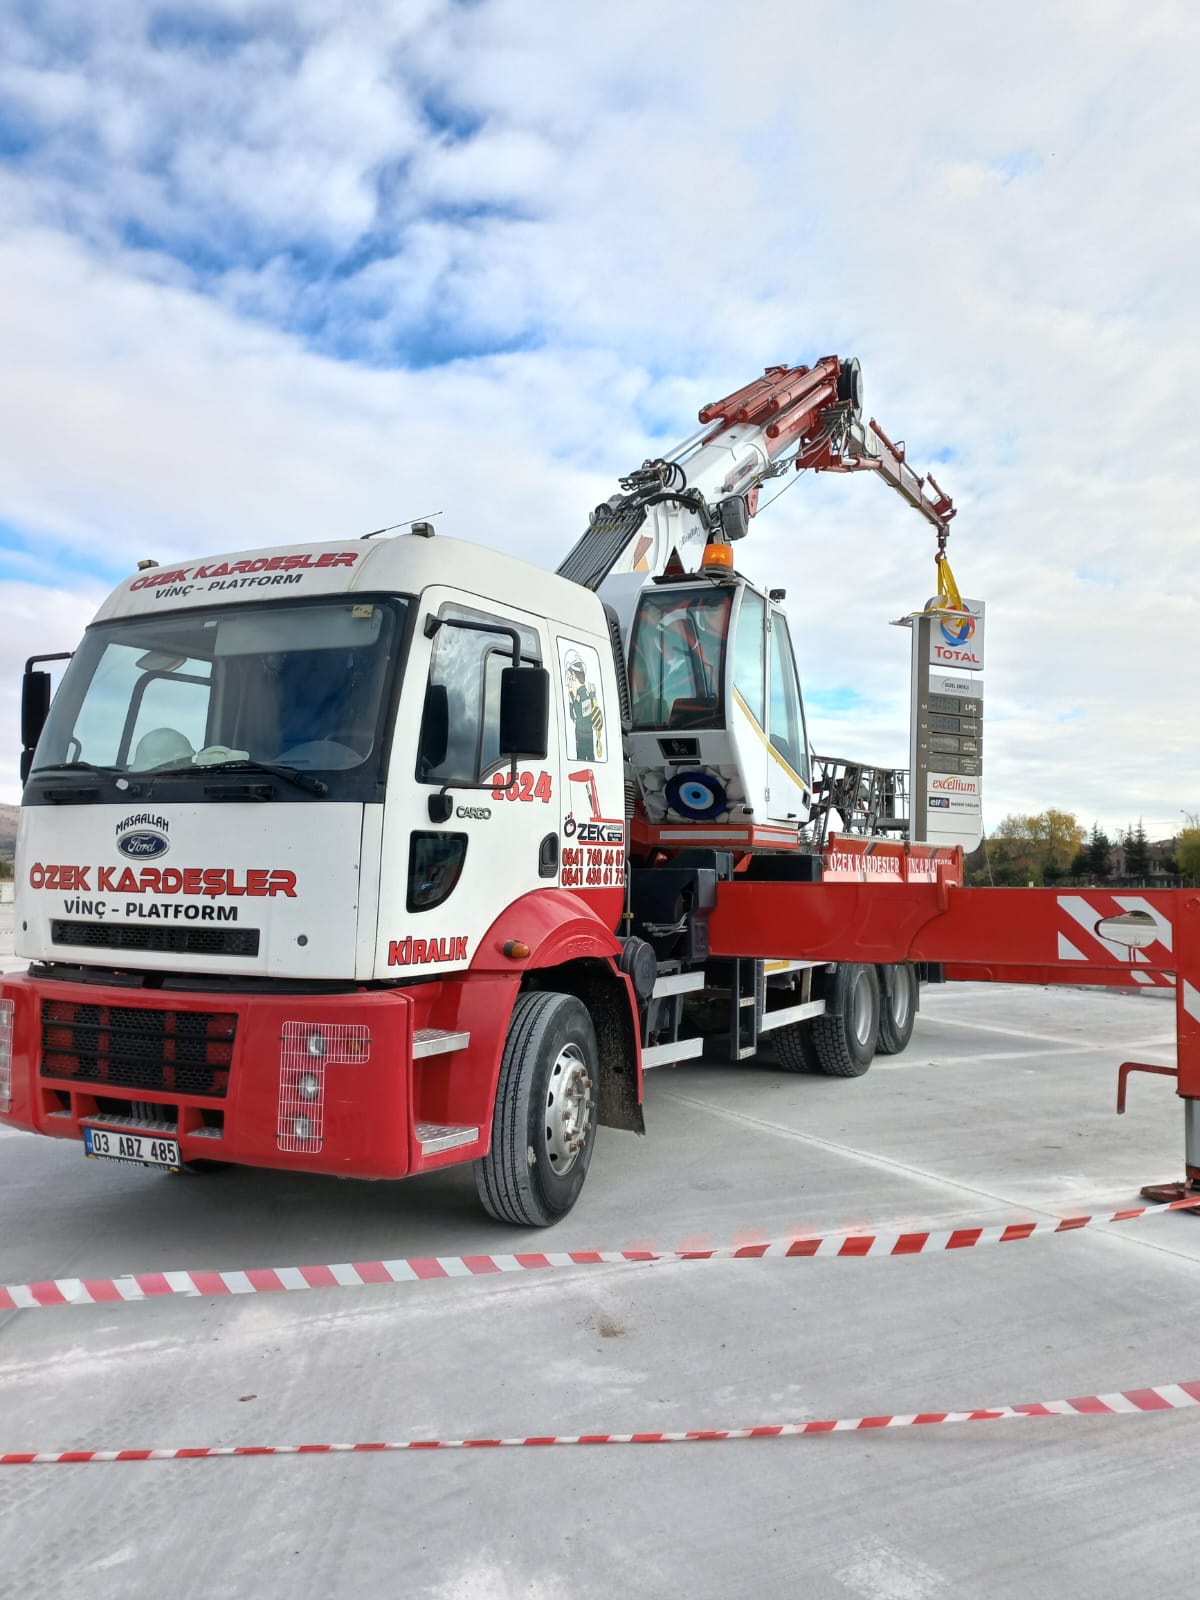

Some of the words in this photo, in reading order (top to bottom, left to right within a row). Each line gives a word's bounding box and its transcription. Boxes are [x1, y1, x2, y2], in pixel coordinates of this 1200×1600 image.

[192, 552, 358, 579] KARDEŞLER
[155, 584, 194, 599] VİNÇ
[208, 573, 303, 592] PLATFORM
[934, 645, 980, 663] TOTAL
[491, 770, 552, 803] 2524
[932, 779, 976, 792] excellium
[456, 806, 491, 820] CARGO
[563, 814, 606, 841] ÖZEK
[127, 834, 157, 852] Ford
[562, 848, 583, 866] 0541
[603, 849, 614, 866] 46
[29, 862, 92, 892] ÖZEK
[97, 866, 297, 900] KARDEŞLER
[561, 867, 583, 886] 0541
[603, 867, 613, 885] 61
[63, 896, 107, 919] VİNÇ
[126, 902, 238, 921] PLATFORM
[387, 936, 468, 966] KİRALIK
[93, 1133, 110, 1153] 03
[119, 1136, 144, 1158] ABZ
[150, 1141, 177, 1163] 485
